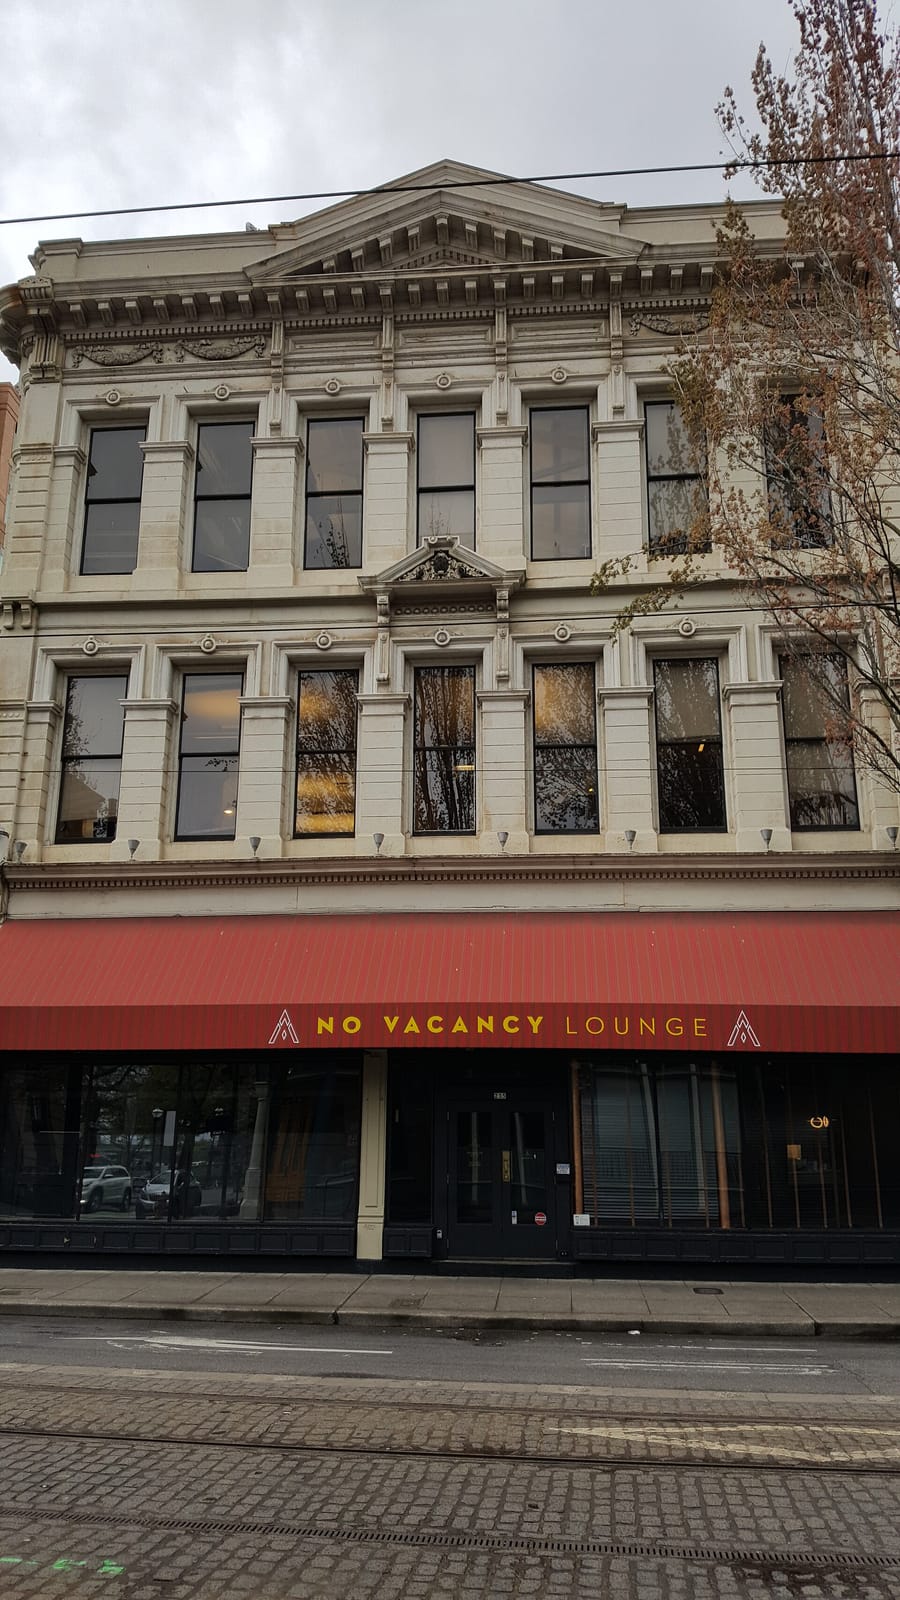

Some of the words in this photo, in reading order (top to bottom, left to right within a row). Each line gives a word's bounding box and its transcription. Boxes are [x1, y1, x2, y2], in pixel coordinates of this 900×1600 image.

[317, 1015, 362, 1034] NO
[384, 1015, 544, 1034] VACANCY
[566, 1016, 708, 1037] LOUNGE
